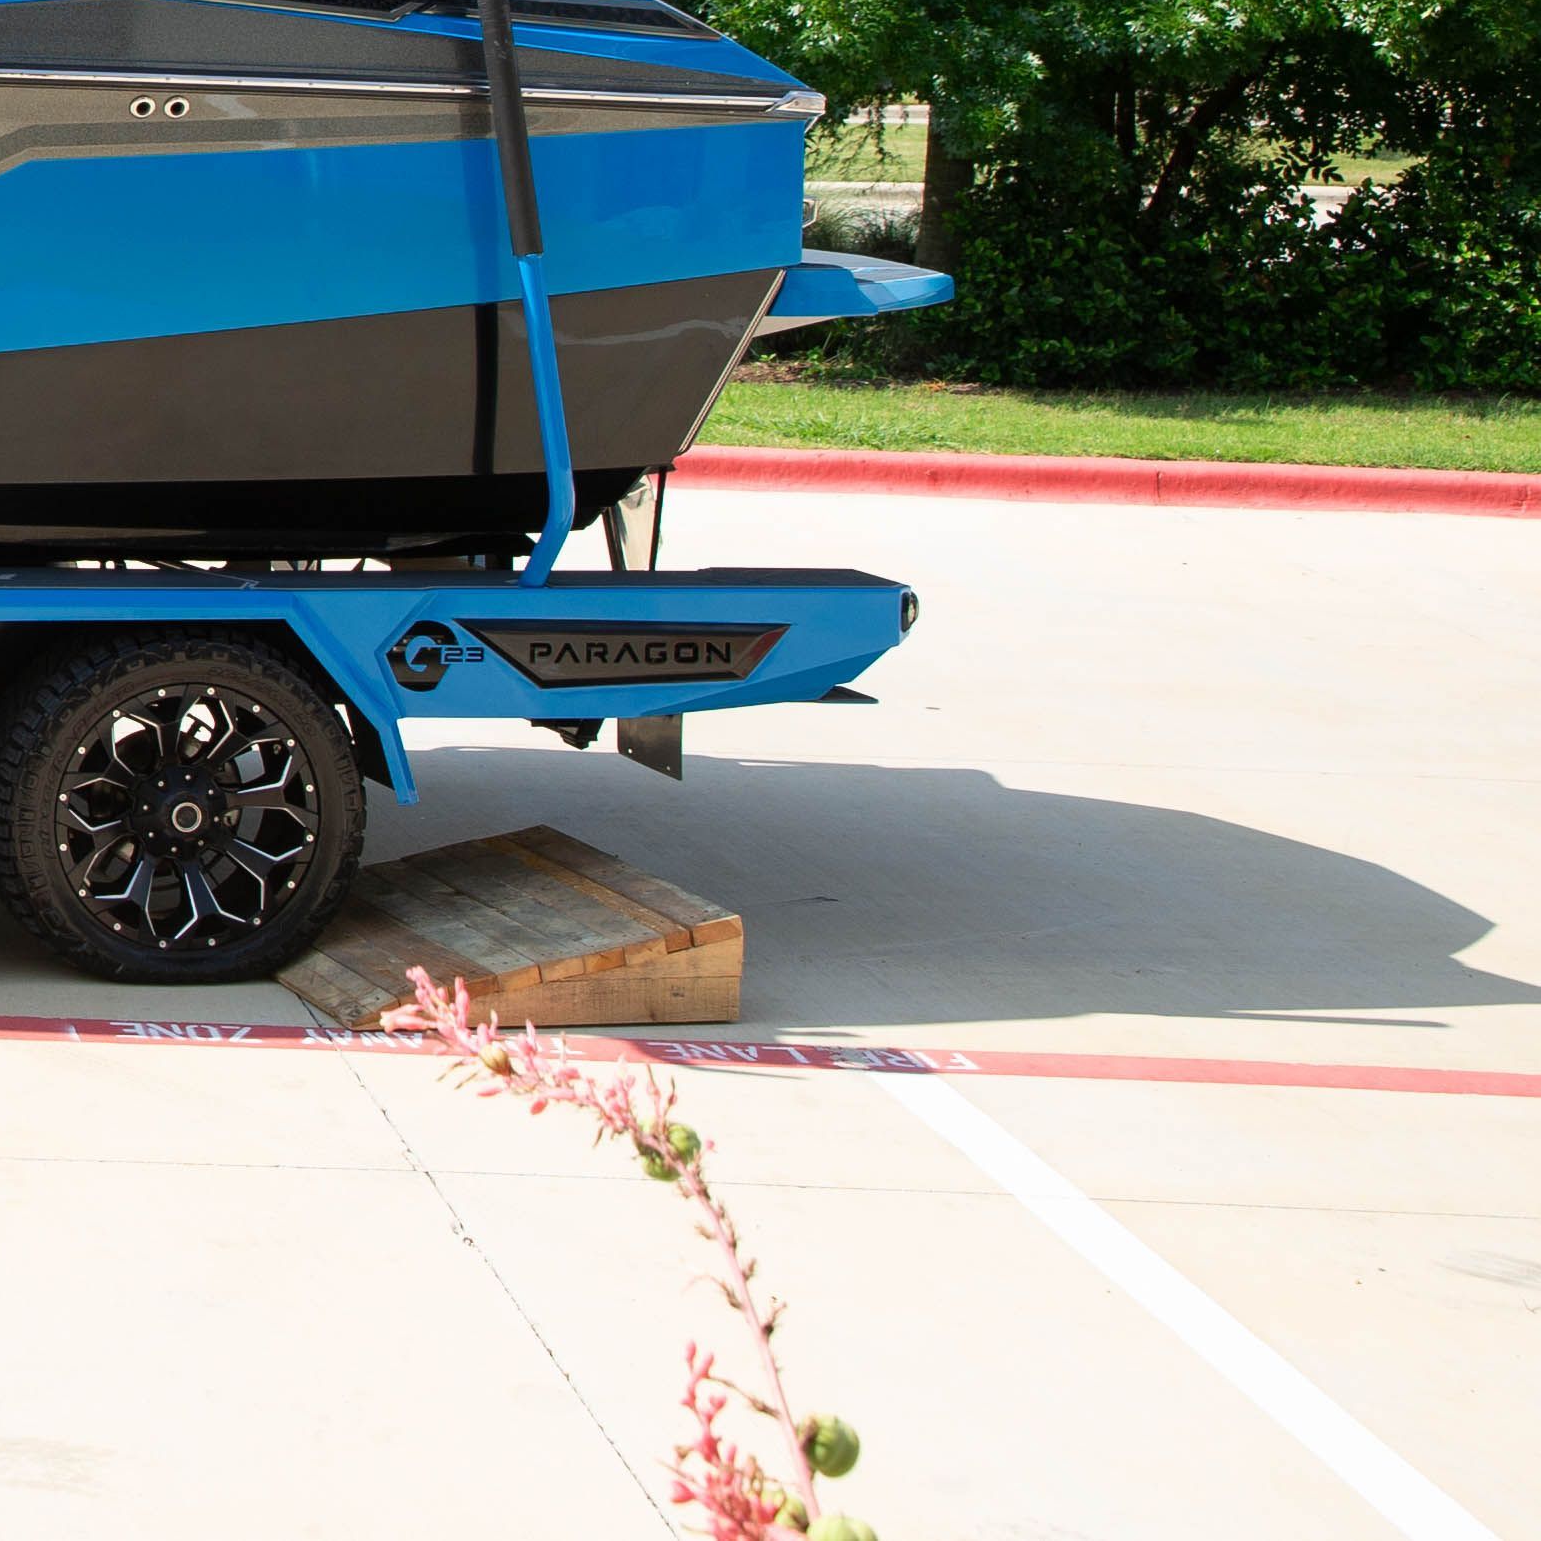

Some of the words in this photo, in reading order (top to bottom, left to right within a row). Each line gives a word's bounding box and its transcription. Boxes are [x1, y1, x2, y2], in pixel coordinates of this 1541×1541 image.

[529, 642, 731, 664] PARAGON
[110, 1021, 262, 1044] ZONE
[646, 1042, 811, 1064] LANE
